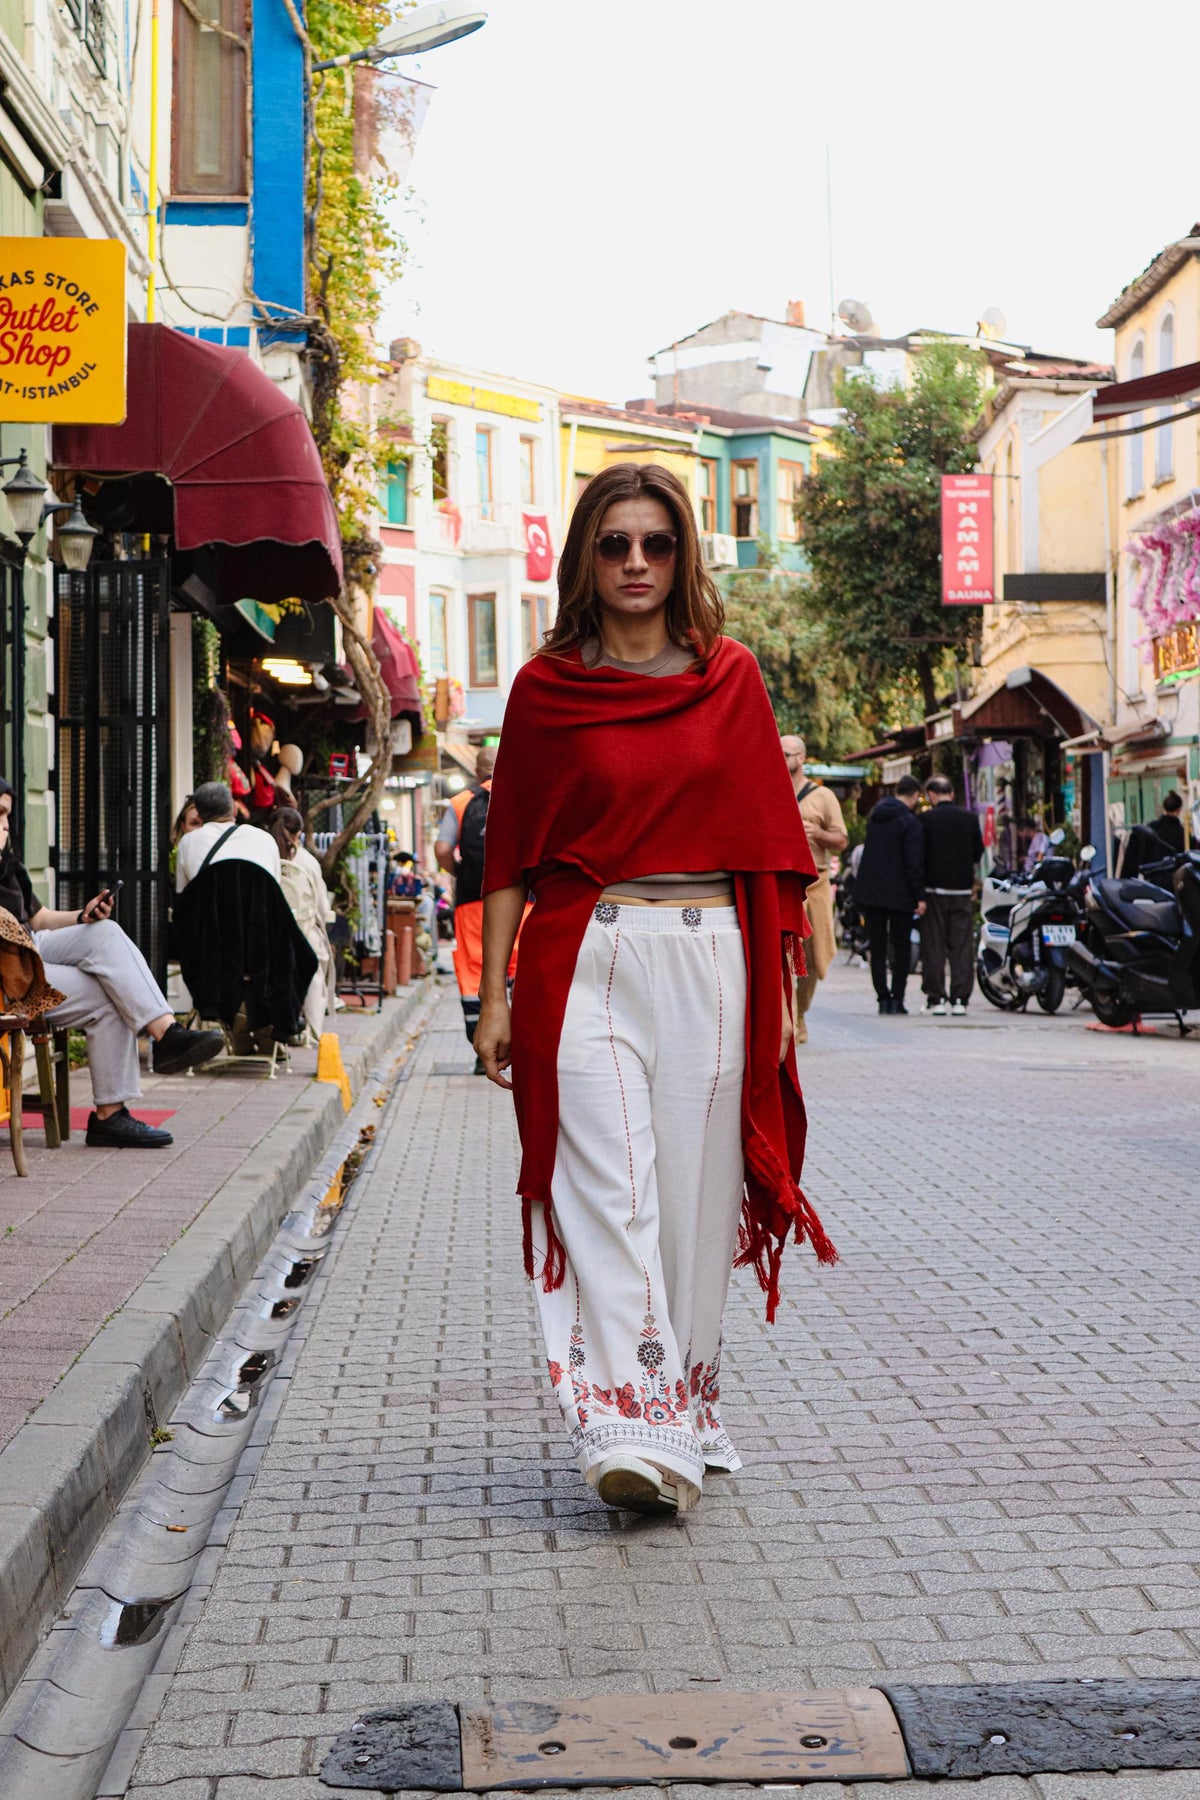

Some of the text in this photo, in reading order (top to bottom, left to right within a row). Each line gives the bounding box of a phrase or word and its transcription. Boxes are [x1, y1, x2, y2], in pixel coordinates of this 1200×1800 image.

[44, 272, 99, 316] STORE
[0, 331, 71, 377] Shop
[948, 590, 993, 600] SAUNA
